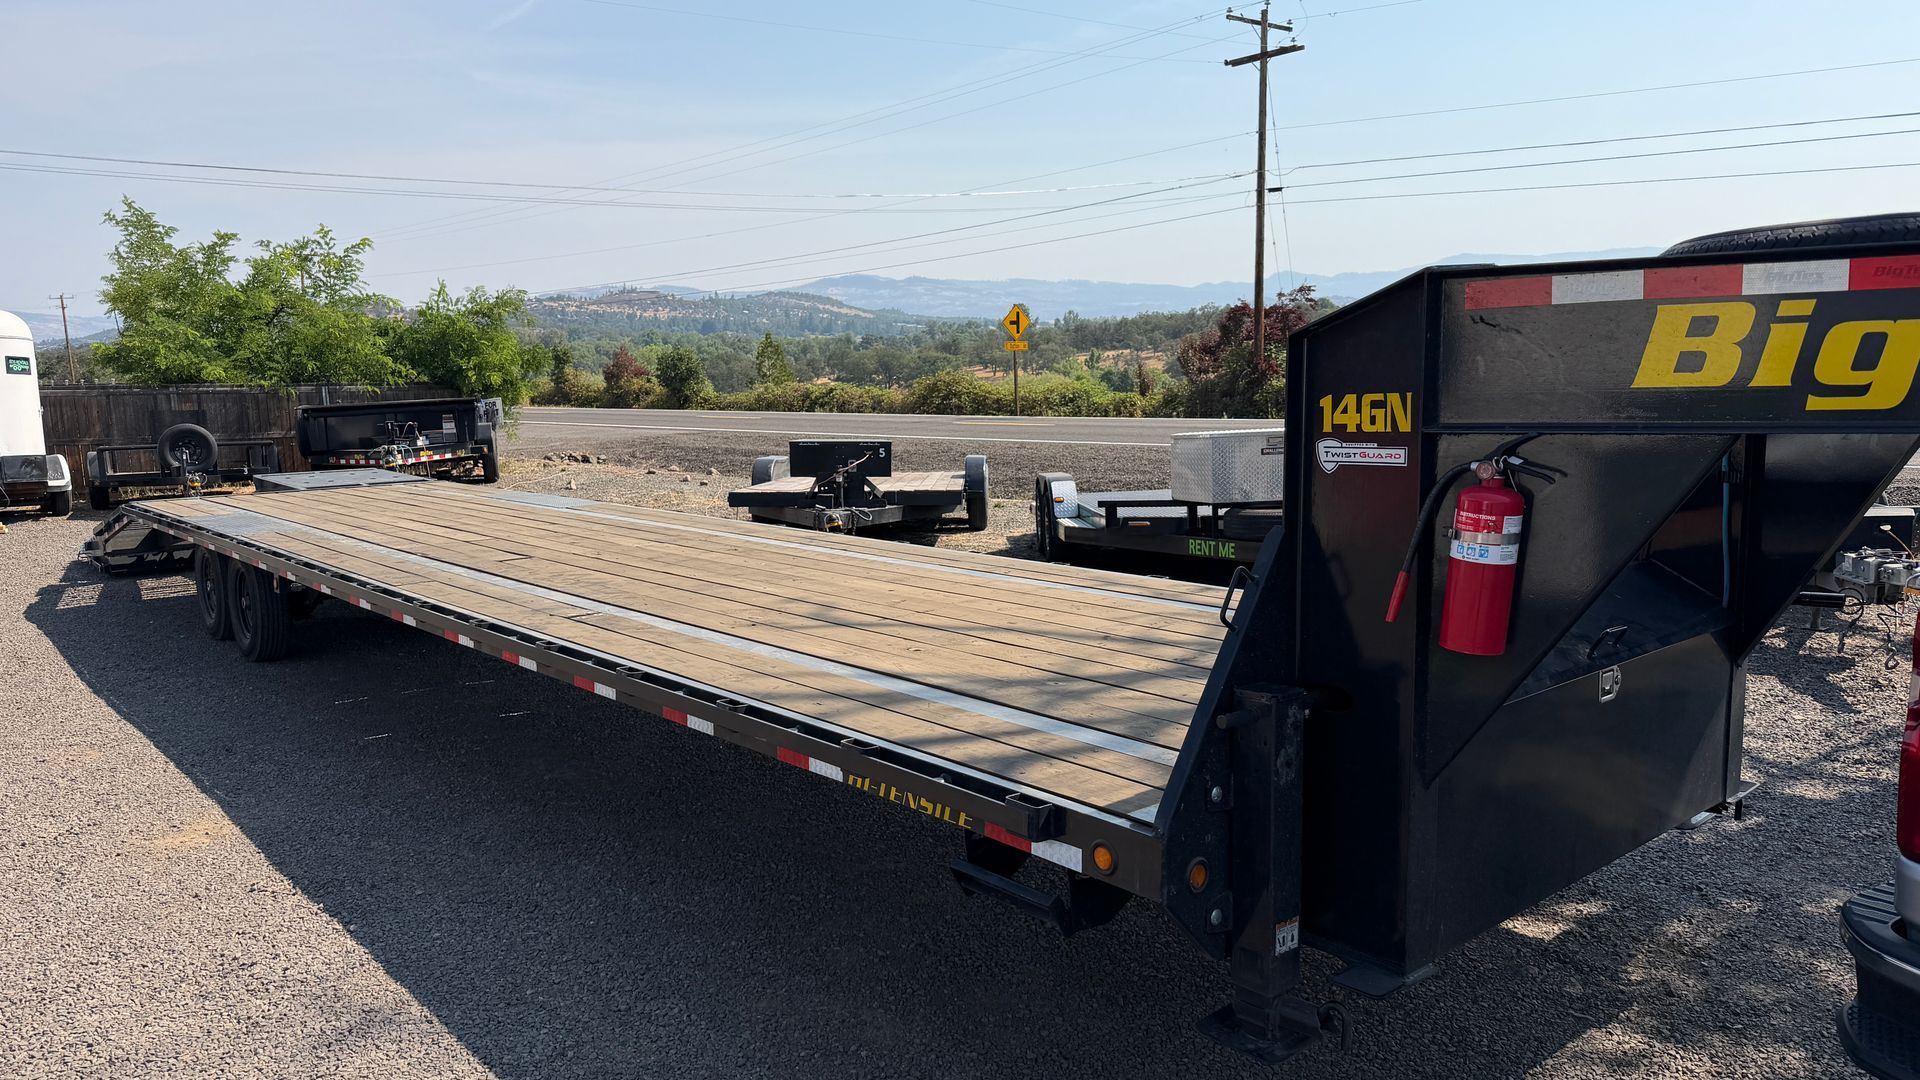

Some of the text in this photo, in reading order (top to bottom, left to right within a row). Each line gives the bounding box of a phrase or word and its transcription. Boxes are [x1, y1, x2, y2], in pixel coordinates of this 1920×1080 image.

[1630, 299, 1920, 411] Big
[1320, 392, 1412, 433] 14GN
[879, 447, 886, 458] 5
[1189, 539, 1236, 558] RENT ME
